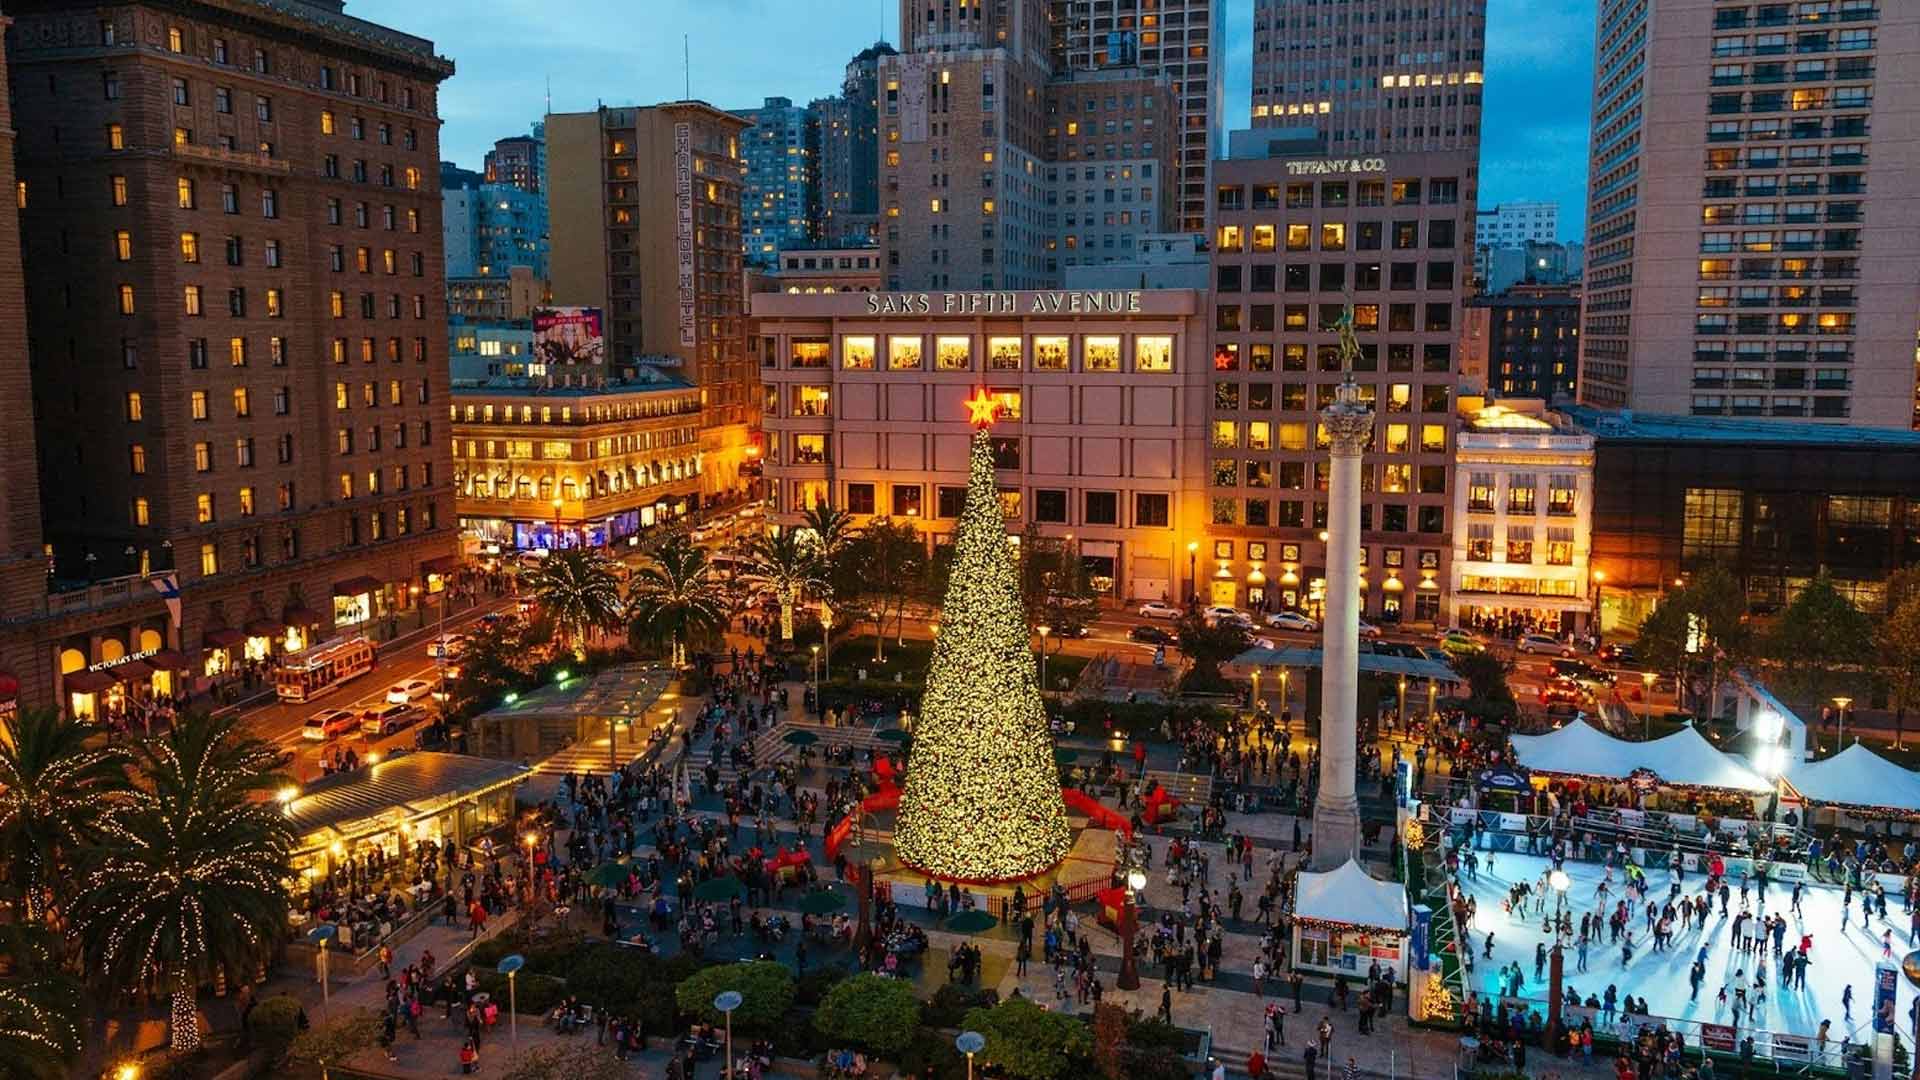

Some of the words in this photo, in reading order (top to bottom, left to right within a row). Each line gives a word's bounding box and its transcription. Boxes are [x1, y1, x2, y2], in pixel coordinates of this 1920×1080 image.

[1286, 160, 1348, 175] TIFFANY
[1350, 159, 1361, 172] &
[679, 126, 692, 265] CHANCELLOR
[680, 273, 694, 342] HOTEL
[867, 293, 929, 314] SAKS
[943, 293, 1016, 313] FIFTH
[1031, 291, 1142, 313] AVENUE
